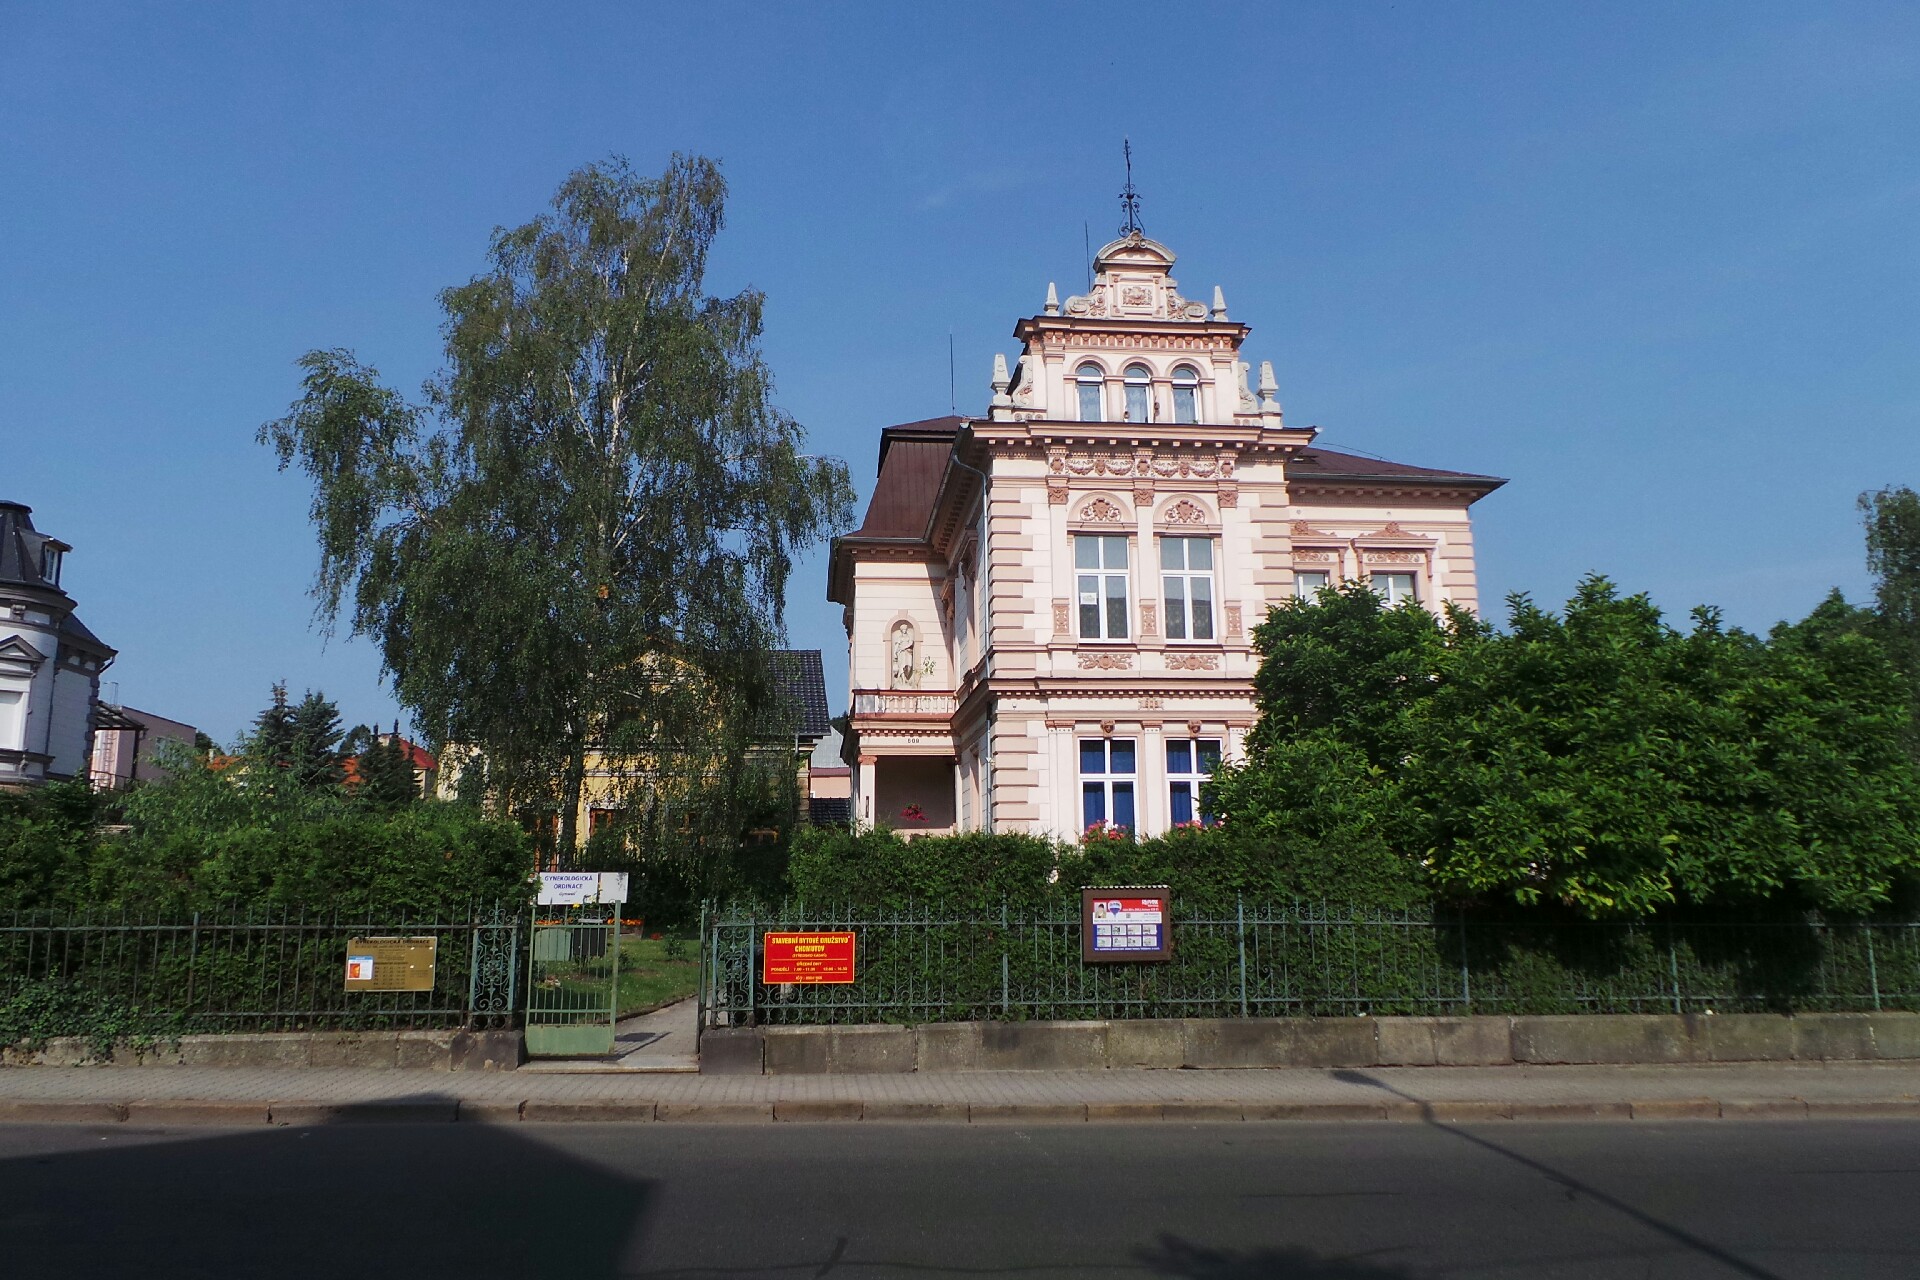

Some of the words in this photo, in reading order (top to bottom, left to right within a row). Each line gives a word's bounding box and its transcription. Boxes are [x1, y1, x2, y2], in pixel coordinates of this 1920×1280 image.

[772, 936, 798, 944] STAVEBNÍ
[799, 936, 820, 944] BYTOVÉ
[820, 936, 848, 944] DRUŽSTVO
